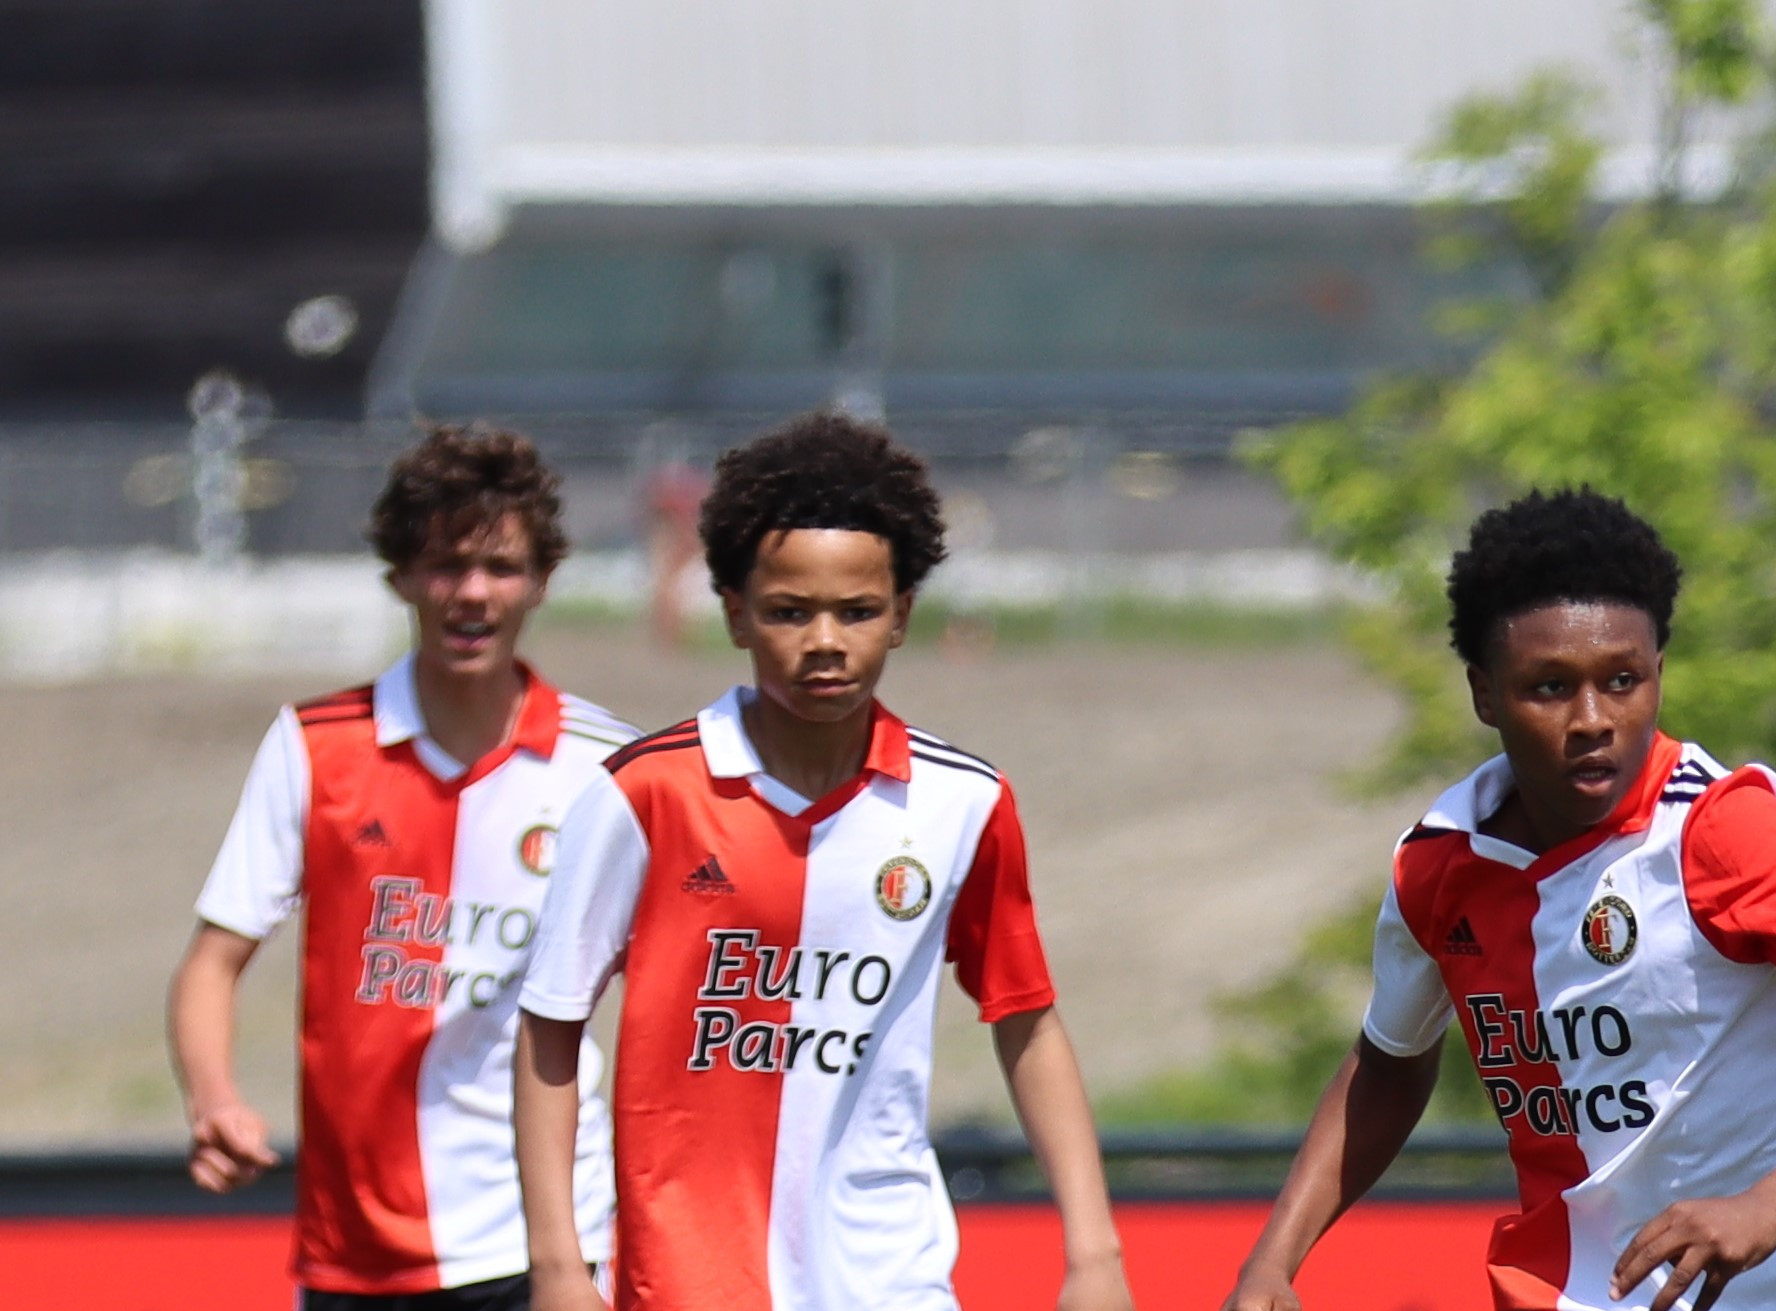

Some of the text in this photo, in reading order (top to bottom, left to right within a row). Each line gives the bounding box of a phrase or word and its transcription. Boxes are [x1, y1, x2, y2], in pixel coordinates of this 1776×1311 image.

[364, 875, 539, 950] Euro
[697, 928, 891, 1006] Euro
[1465, 993, 1632, 1068] Euro
[1482, 1075, 1656, 1136] Parcs
